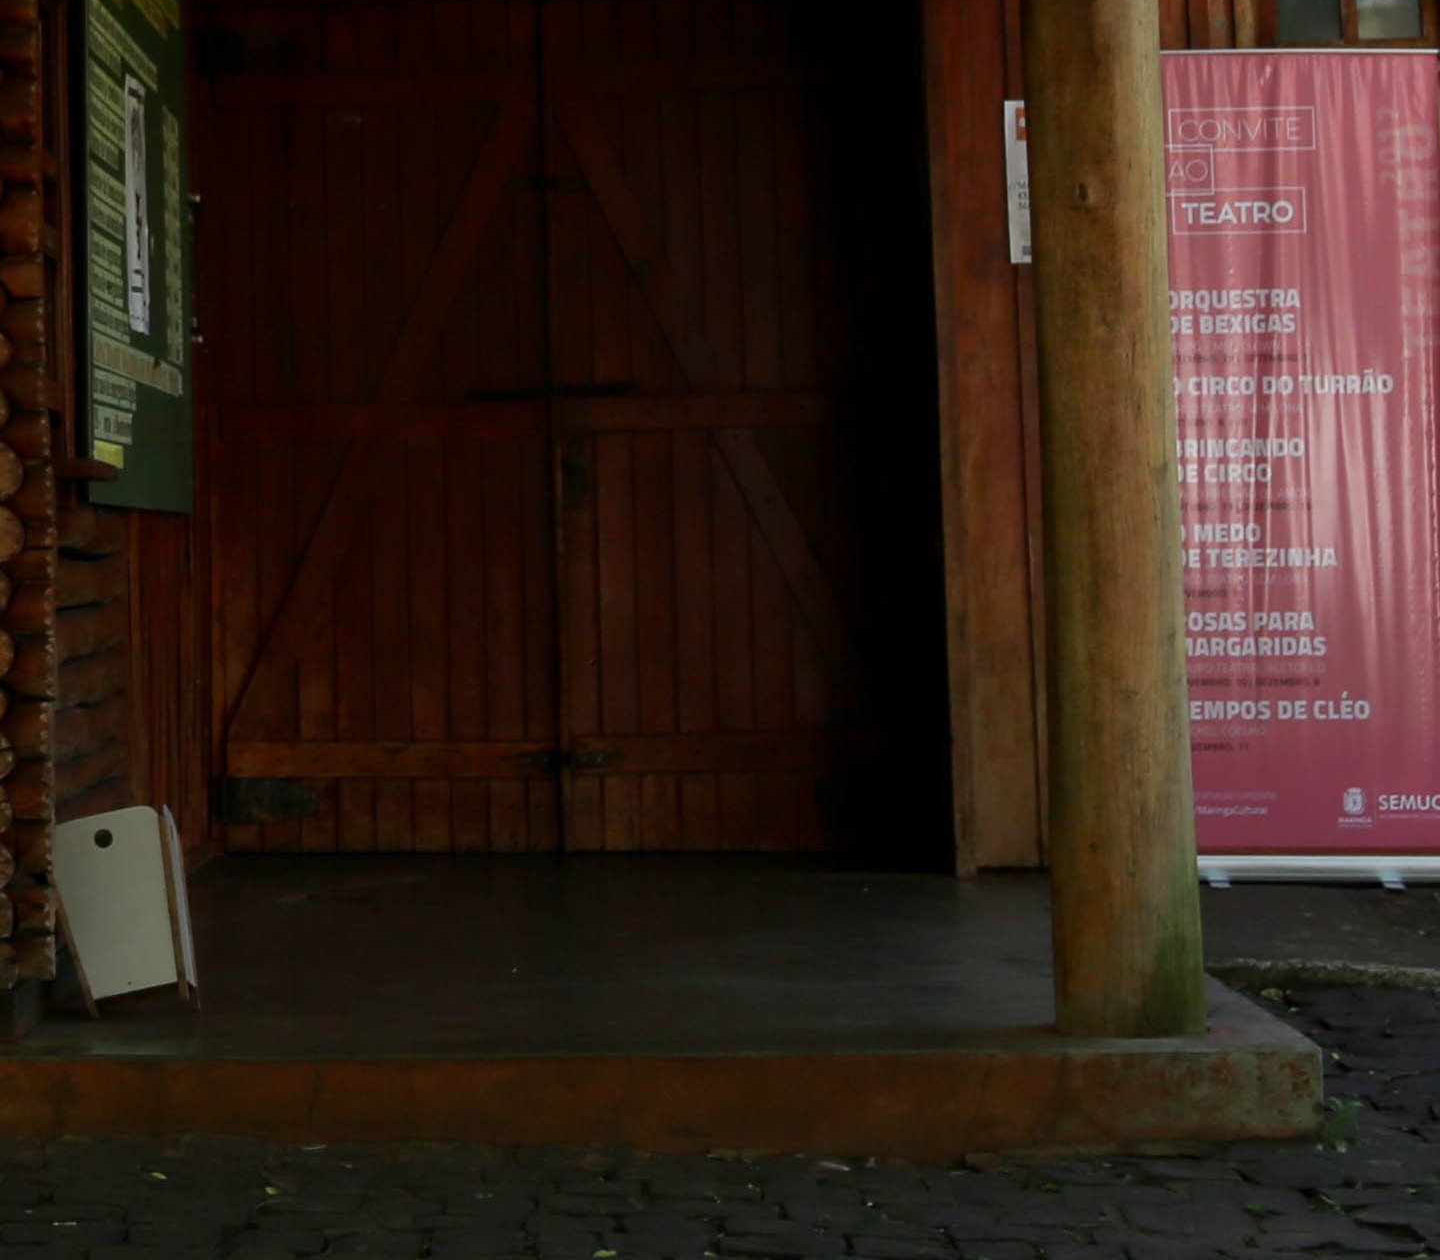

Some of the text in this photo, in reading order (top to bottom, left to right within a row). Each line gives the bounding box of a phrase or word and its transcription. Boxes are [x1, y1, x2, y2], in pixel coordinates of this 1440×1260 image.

[1178, 116, 1302, 142] CONVITE
[1168, 159, 1209, 182] AO
[1181, 200, 1294, 225] TEATRO
[1168, 289, 1301, 312] ORQUESTRA
[1199, 313, 1297, 335] BEXIGAS
[1187, 375, 1257, 396] CIRCO
[1262, 374, 1294, 396] DO
[1203, 463, 1273, 483] CIRCO
[1193, 522, 1262, 543] MEDO
[1206, 546, 1338, 568] TEREZINHA
[1185, 611, 1315, 632] OSAS PARA
[1189, 690, 1371, 721] EMPOS DE CLÉO
